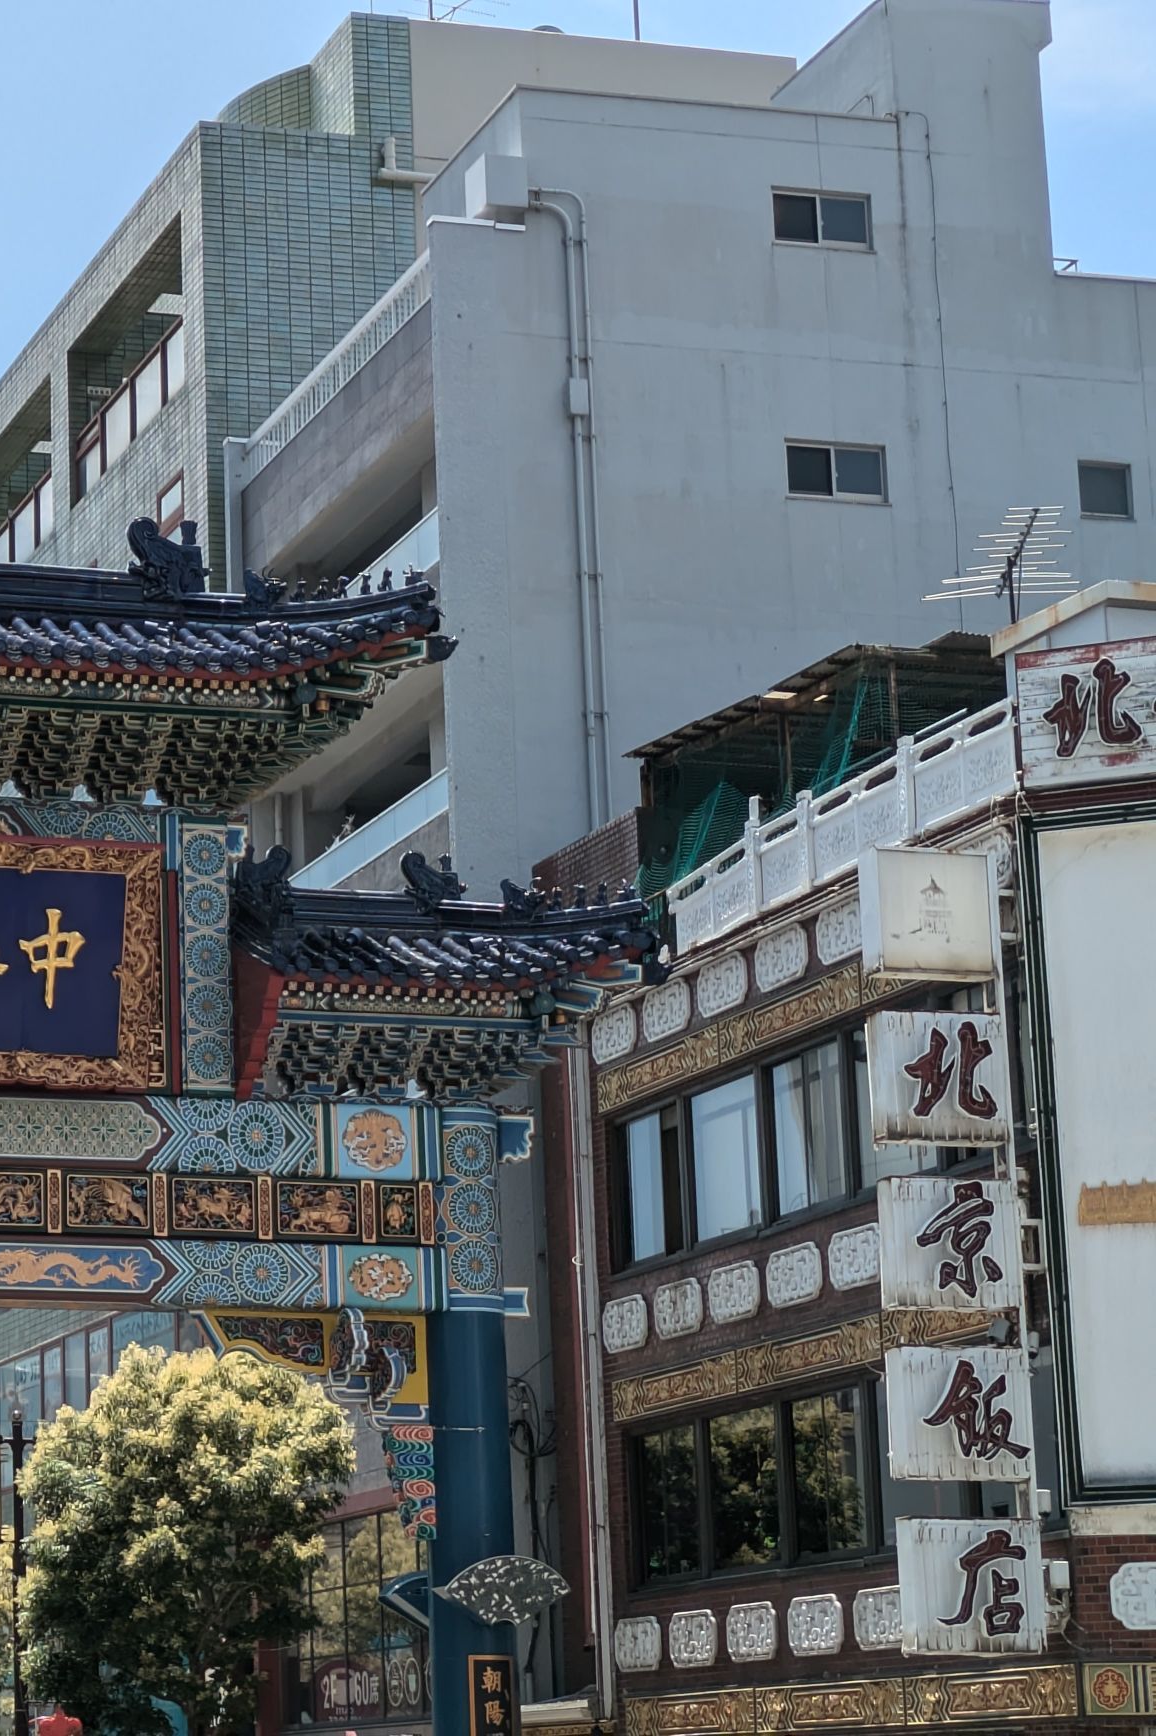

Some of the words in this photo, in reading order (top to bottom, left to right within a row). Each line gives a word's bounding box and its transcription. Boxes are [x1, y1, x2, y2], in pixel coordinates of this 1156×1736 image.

[1042, 656, 1156, 759] 北
[903, 1020, 1032, 1637] 北京飯店
[481, 1666, 506, 1736] 朝陽
